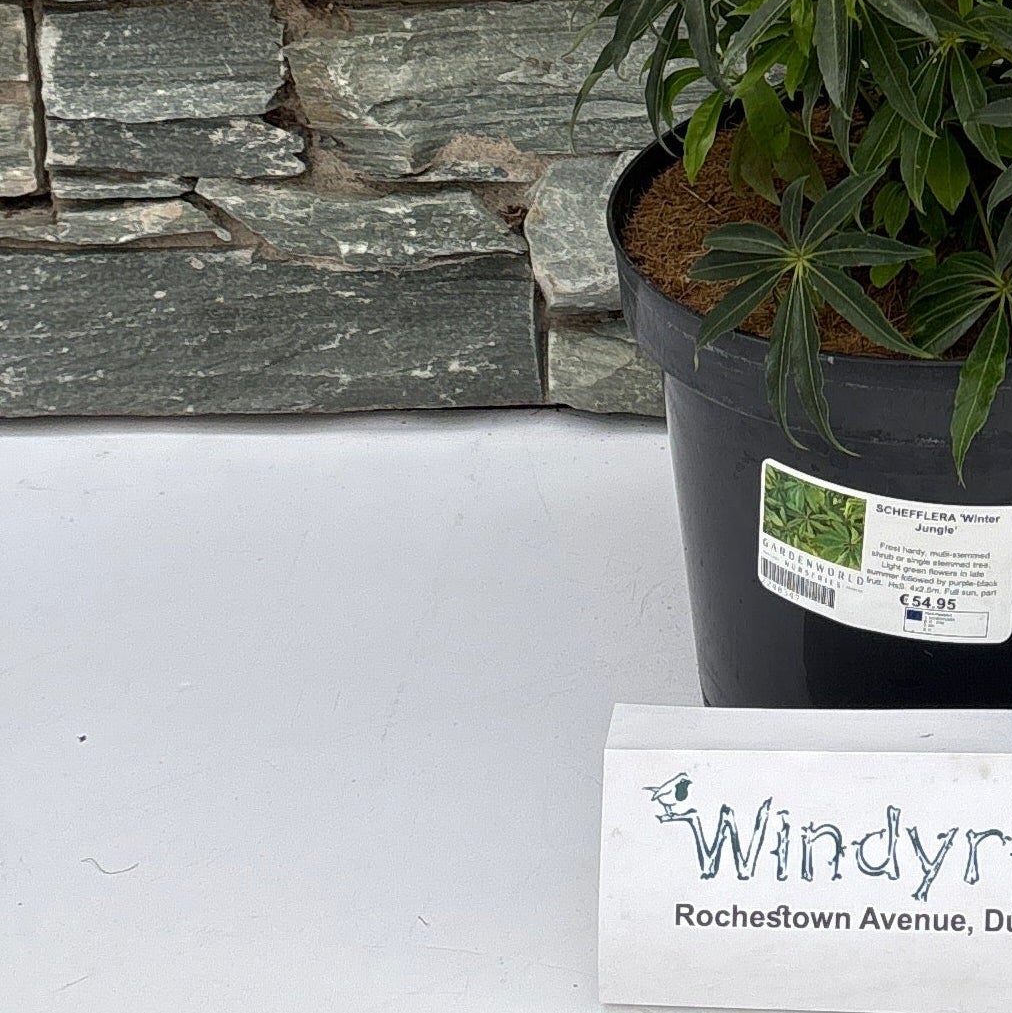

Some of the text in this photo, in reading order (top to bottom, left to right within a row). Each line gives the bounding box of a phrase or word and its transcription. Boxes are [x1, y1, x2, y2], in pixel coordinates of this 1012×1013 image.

[876, 503, 957, 522] SCHEFFLERA
[915, 523, 958, 535] Jungle'
[879, 541, 901, 553] Frost
[762, 537, 864, 586] GARDENWORLD
[871, 550, 894, 561] shrub
[906, 556, 931, 566] single
[932, 559, 971, 569] stemmed
[881, 560, 985, 578] Light green flowers in late
[866, 568, 900, 580] summer
[900, 573, 935, 585] followed
[936, 577, 947, 587] by
[980, 589, 998, 598] part
[675, 903, 851, 930] Rochestown
[859, 906, 974, 936] Avenue,
